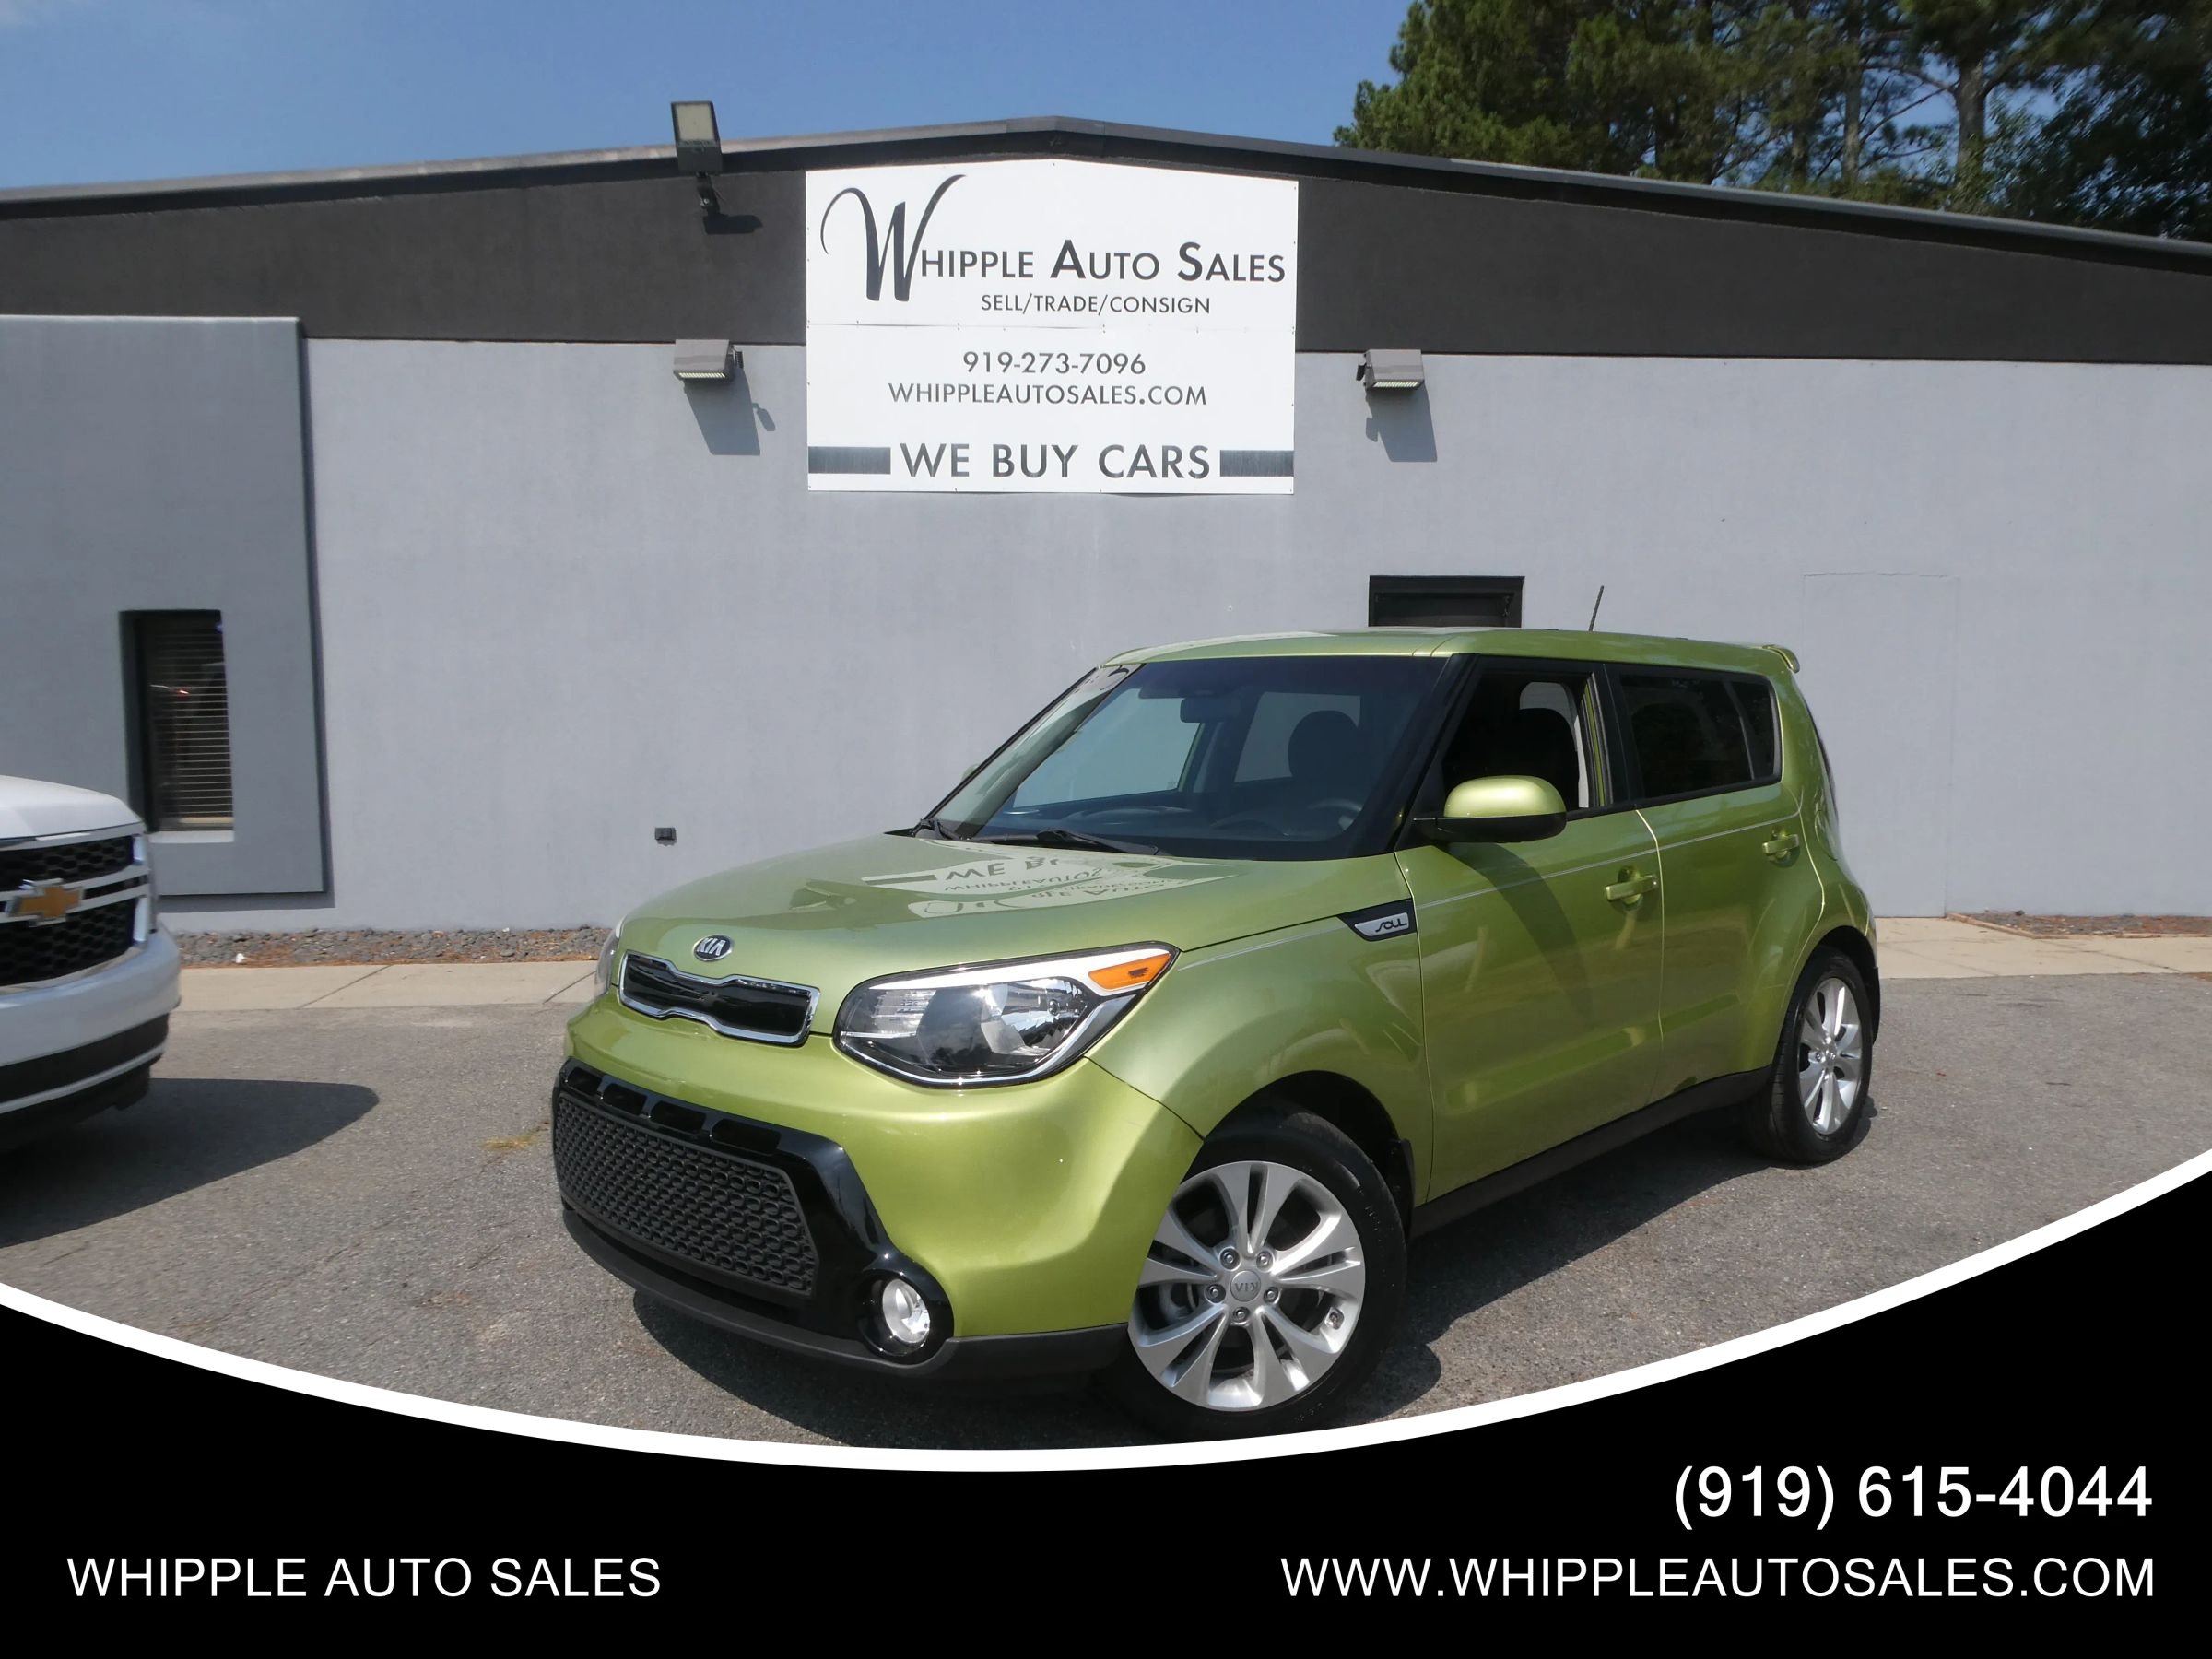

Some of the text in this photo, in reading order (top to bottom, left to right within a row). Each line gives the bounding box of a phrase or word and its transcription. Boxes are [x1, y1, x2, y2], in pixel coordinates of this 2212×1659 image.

[819, 174, 1286, 302] WHIPPLE AUTO SALES
[981, 293, 1210, 315] SELL/TRADE/CONSIGN
[963, 351, 1146, 375] 919-273-7096
[888, 382, 1206, 406] WHIPPLEAUTOSALES.COM
[900, 443, 1210, 479] WE BUY CARS
[1375, 918, 1407, 933] SOUL
[697, 937, 726, 956] KIA
